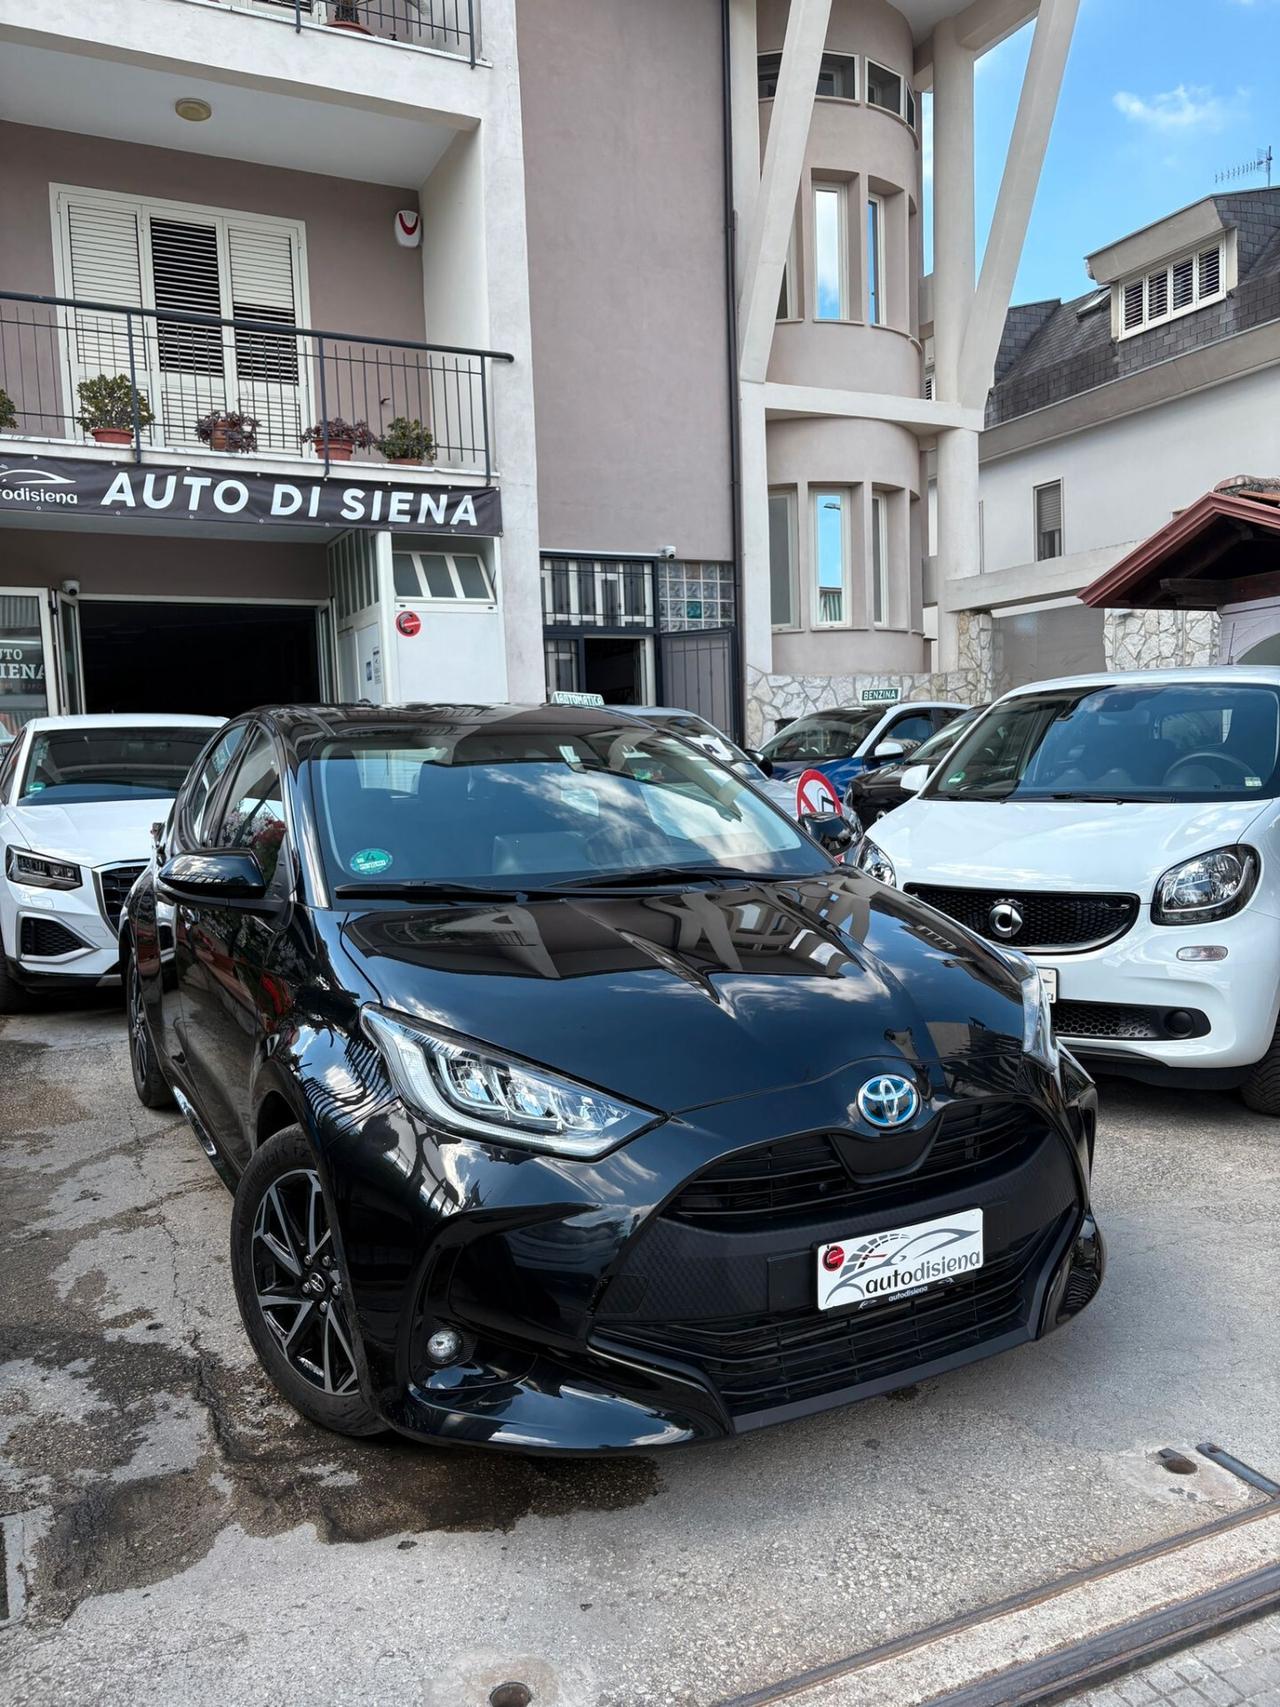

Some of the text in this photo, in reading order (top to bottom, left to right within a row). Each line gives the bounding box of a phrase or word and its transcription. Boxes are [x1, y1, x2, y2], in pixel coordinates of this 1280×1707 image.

[0, 487, 78, 505] odisiena
[100, 471, 478, 527] AUTO DI SIENA
[863, 690, 896, 700] BENZINA
[865, 1250, 981, 1294] autodisiena
[888, 1285, 929, 1302] autodisiena
